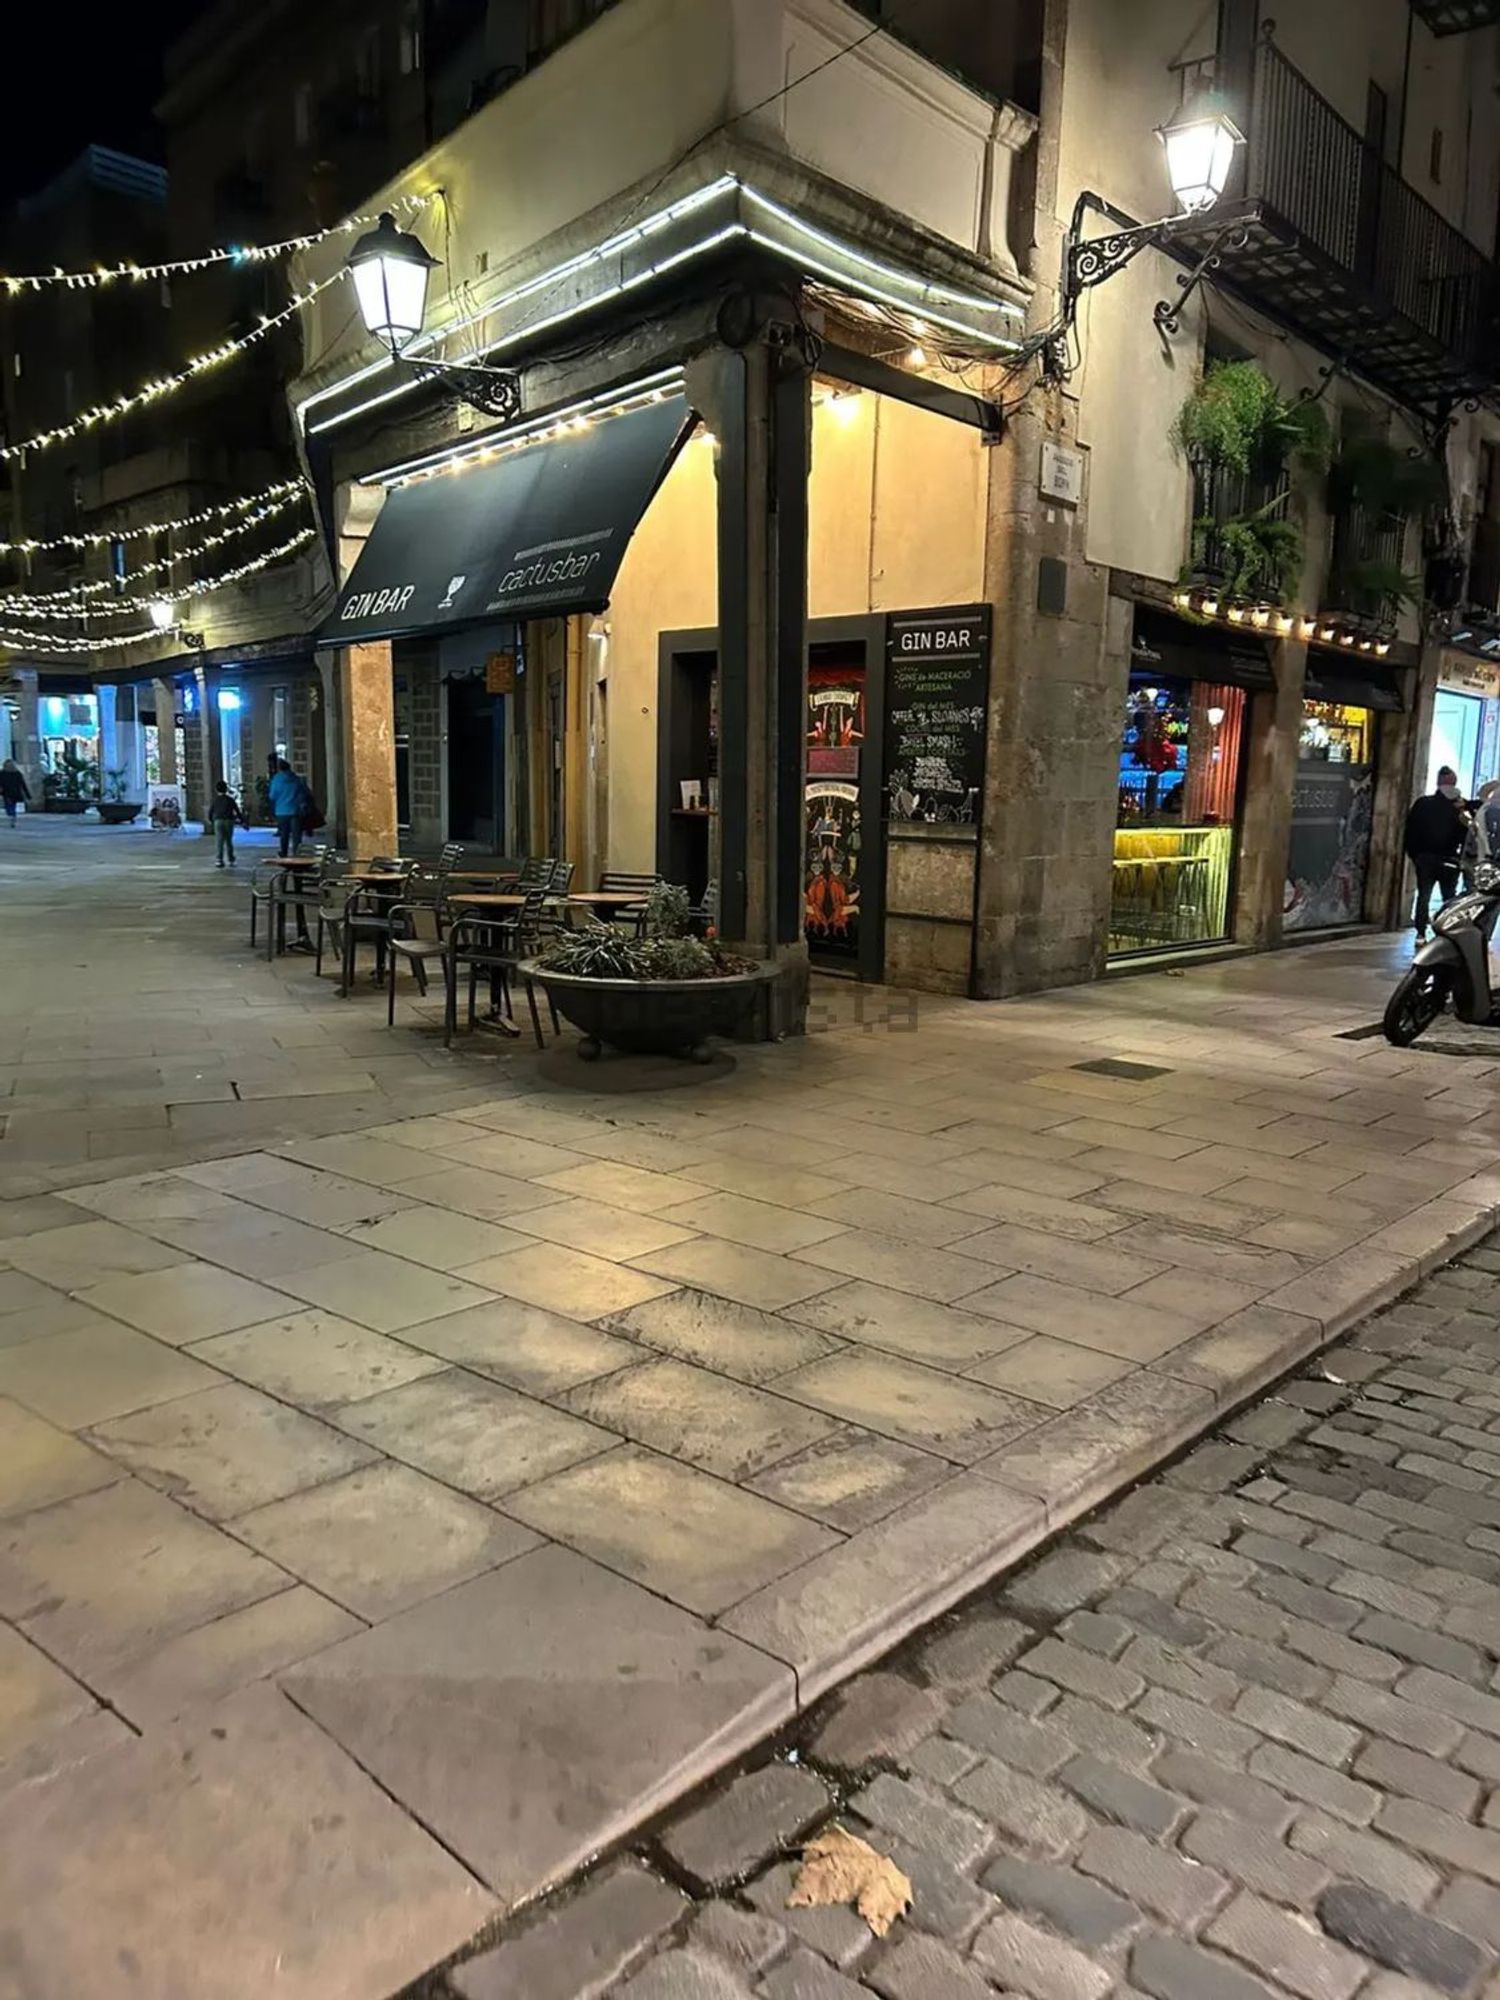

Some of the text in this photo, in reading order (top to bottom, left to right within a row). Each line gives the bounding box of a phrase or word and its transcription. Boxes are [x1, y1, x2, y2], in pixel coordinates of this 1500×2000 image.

[498, 551, 600, 594] cactusbar
[341, 584, 415, 621] GIN BAR
[901, 629, 971, 651] GIN BAR
